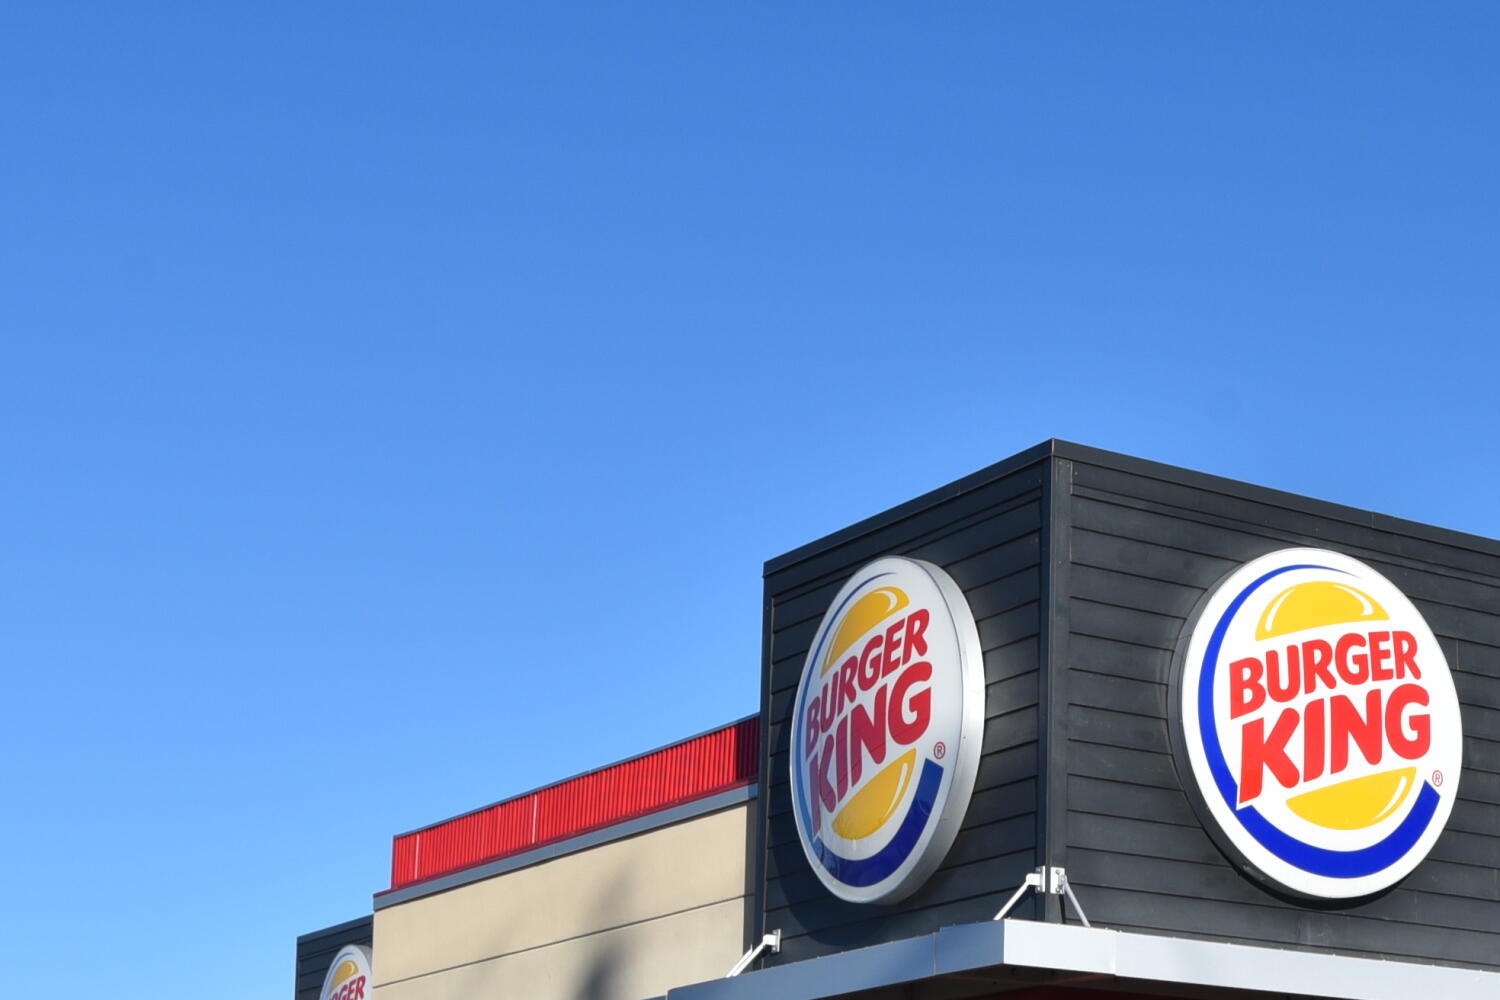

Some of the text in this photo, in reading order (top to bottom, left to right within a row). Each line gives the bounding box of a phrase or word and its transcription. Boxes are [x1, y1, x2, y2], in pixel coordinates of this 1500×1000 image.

[805, 608, 930, 761] BURGER
[1229, 630, 1422, 720] BURGER
[808, 661, 933, 838] KING
[1239, 683, 1432, 805] KING
